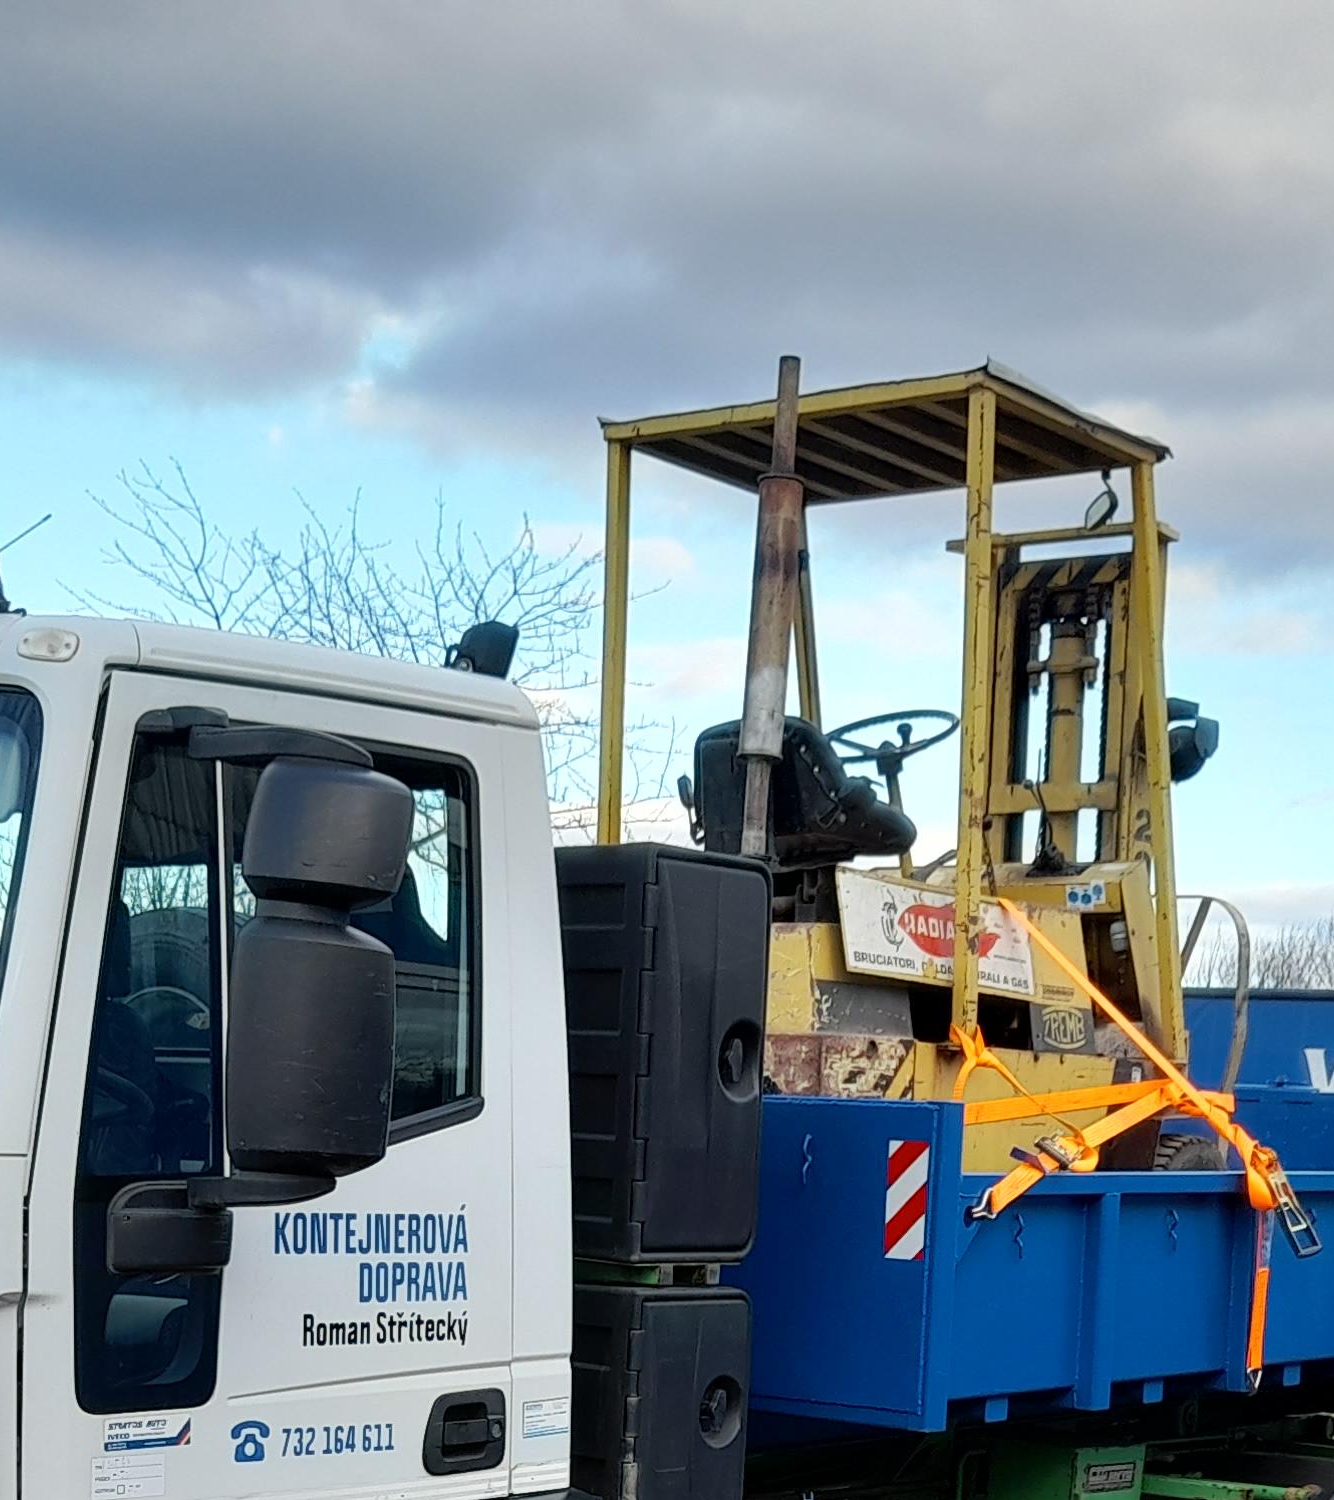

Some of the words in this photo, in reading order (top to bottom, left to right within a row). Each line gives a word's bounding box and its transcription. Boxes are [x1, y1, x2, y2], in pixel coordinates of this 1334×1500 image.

[854, 950, 918, 972] BRUCIATORI,
[1011, 977, 1029, 990] GAS
[274, 1204, 469, 1254] KONTEJNEROVÁ
[359, 1262, 468, 1303] DOPRAVA
[303, 1313, 371, 1346] Roman
[375, 1311, 468, 1346] Střítecký
[282, 1428, 316, 1457] 732
[323, 1425, 356, 1454] 164
[362, 1423, 395, 1452] 611
